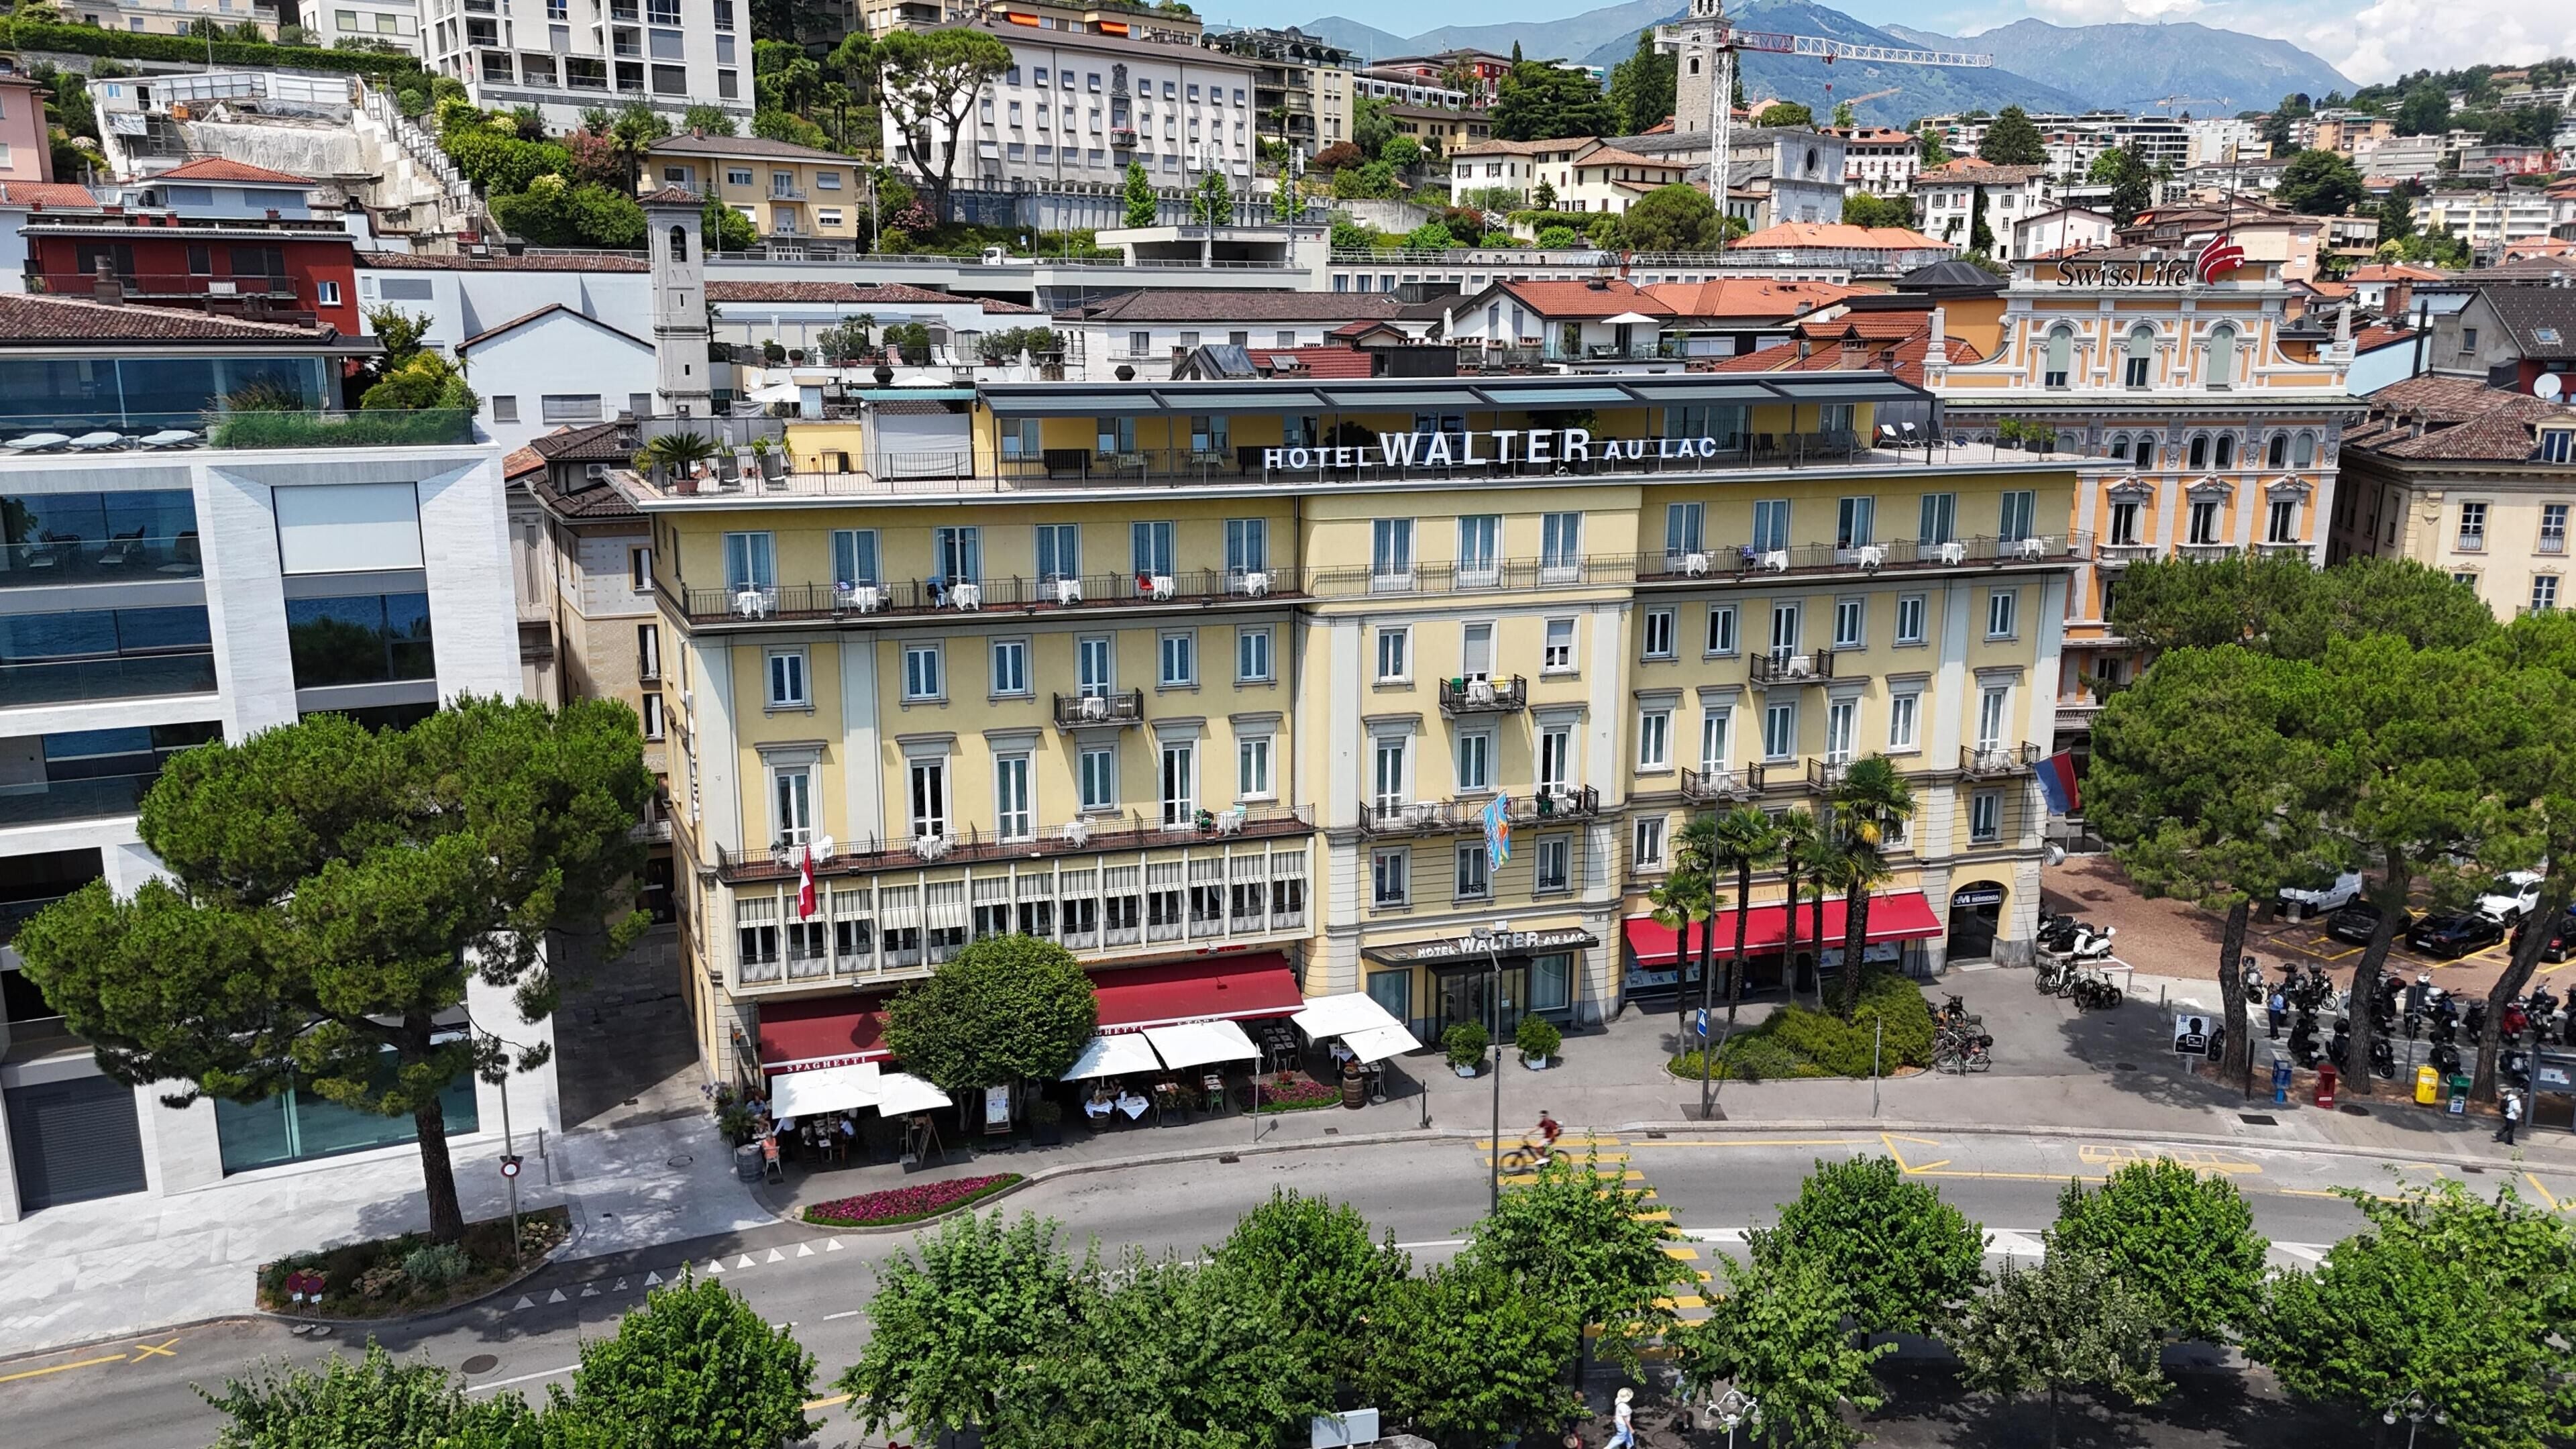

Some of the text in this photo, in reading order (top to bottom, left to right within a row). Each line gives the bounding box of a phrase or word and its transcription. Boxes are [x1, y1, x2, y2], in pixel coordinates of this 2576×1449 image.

[2057, 258, 2188, 286] SwissLife
[1264, 429, 1716, 469] HOTEL WALTER AU LAC
[1417, 932, 1585, 958] HOTEL WALTER AU LAC
[787, 1057, 866, 1073] SPAGHETTI
